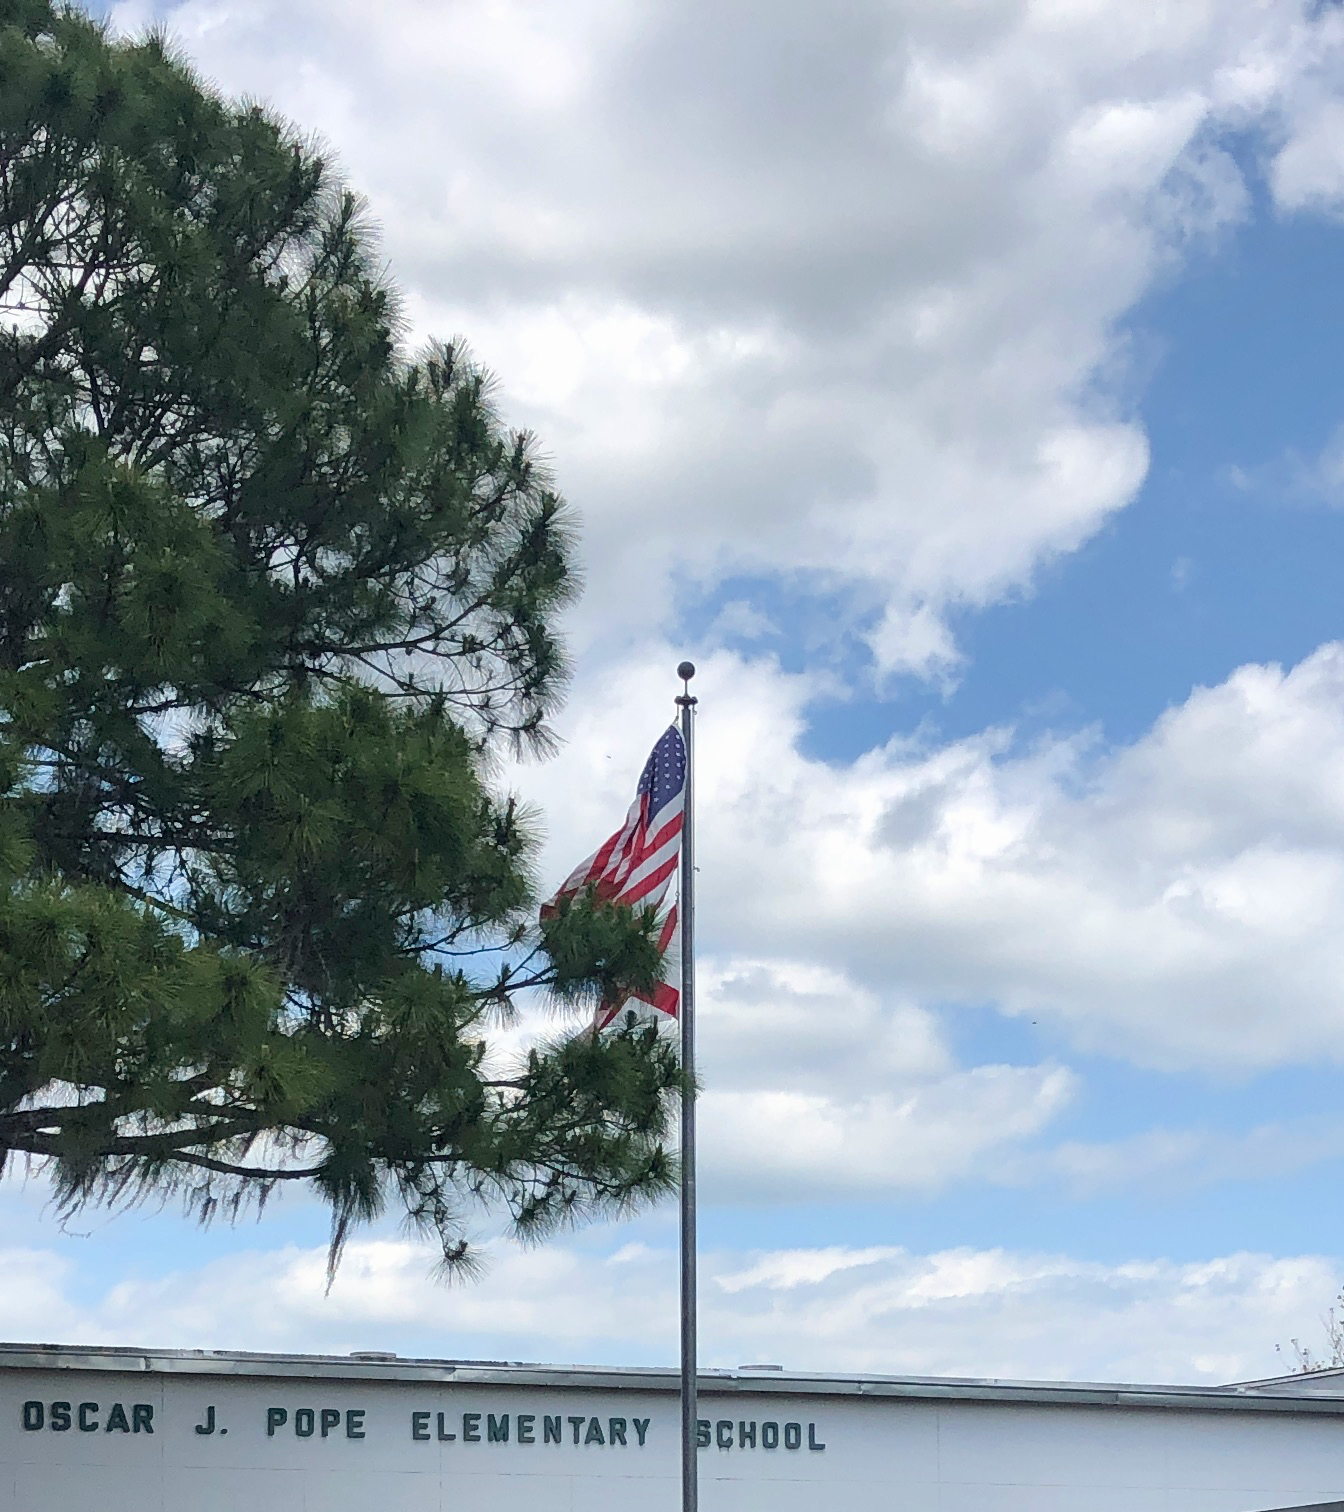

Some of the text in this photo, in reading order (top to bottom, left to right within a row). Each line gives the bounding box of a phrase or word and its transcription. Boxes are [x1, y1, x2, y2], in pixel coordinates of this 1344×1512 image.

[23, 1400, 826, 1450] OSCAR J. POPE ELEMENTARY SCHOOL
